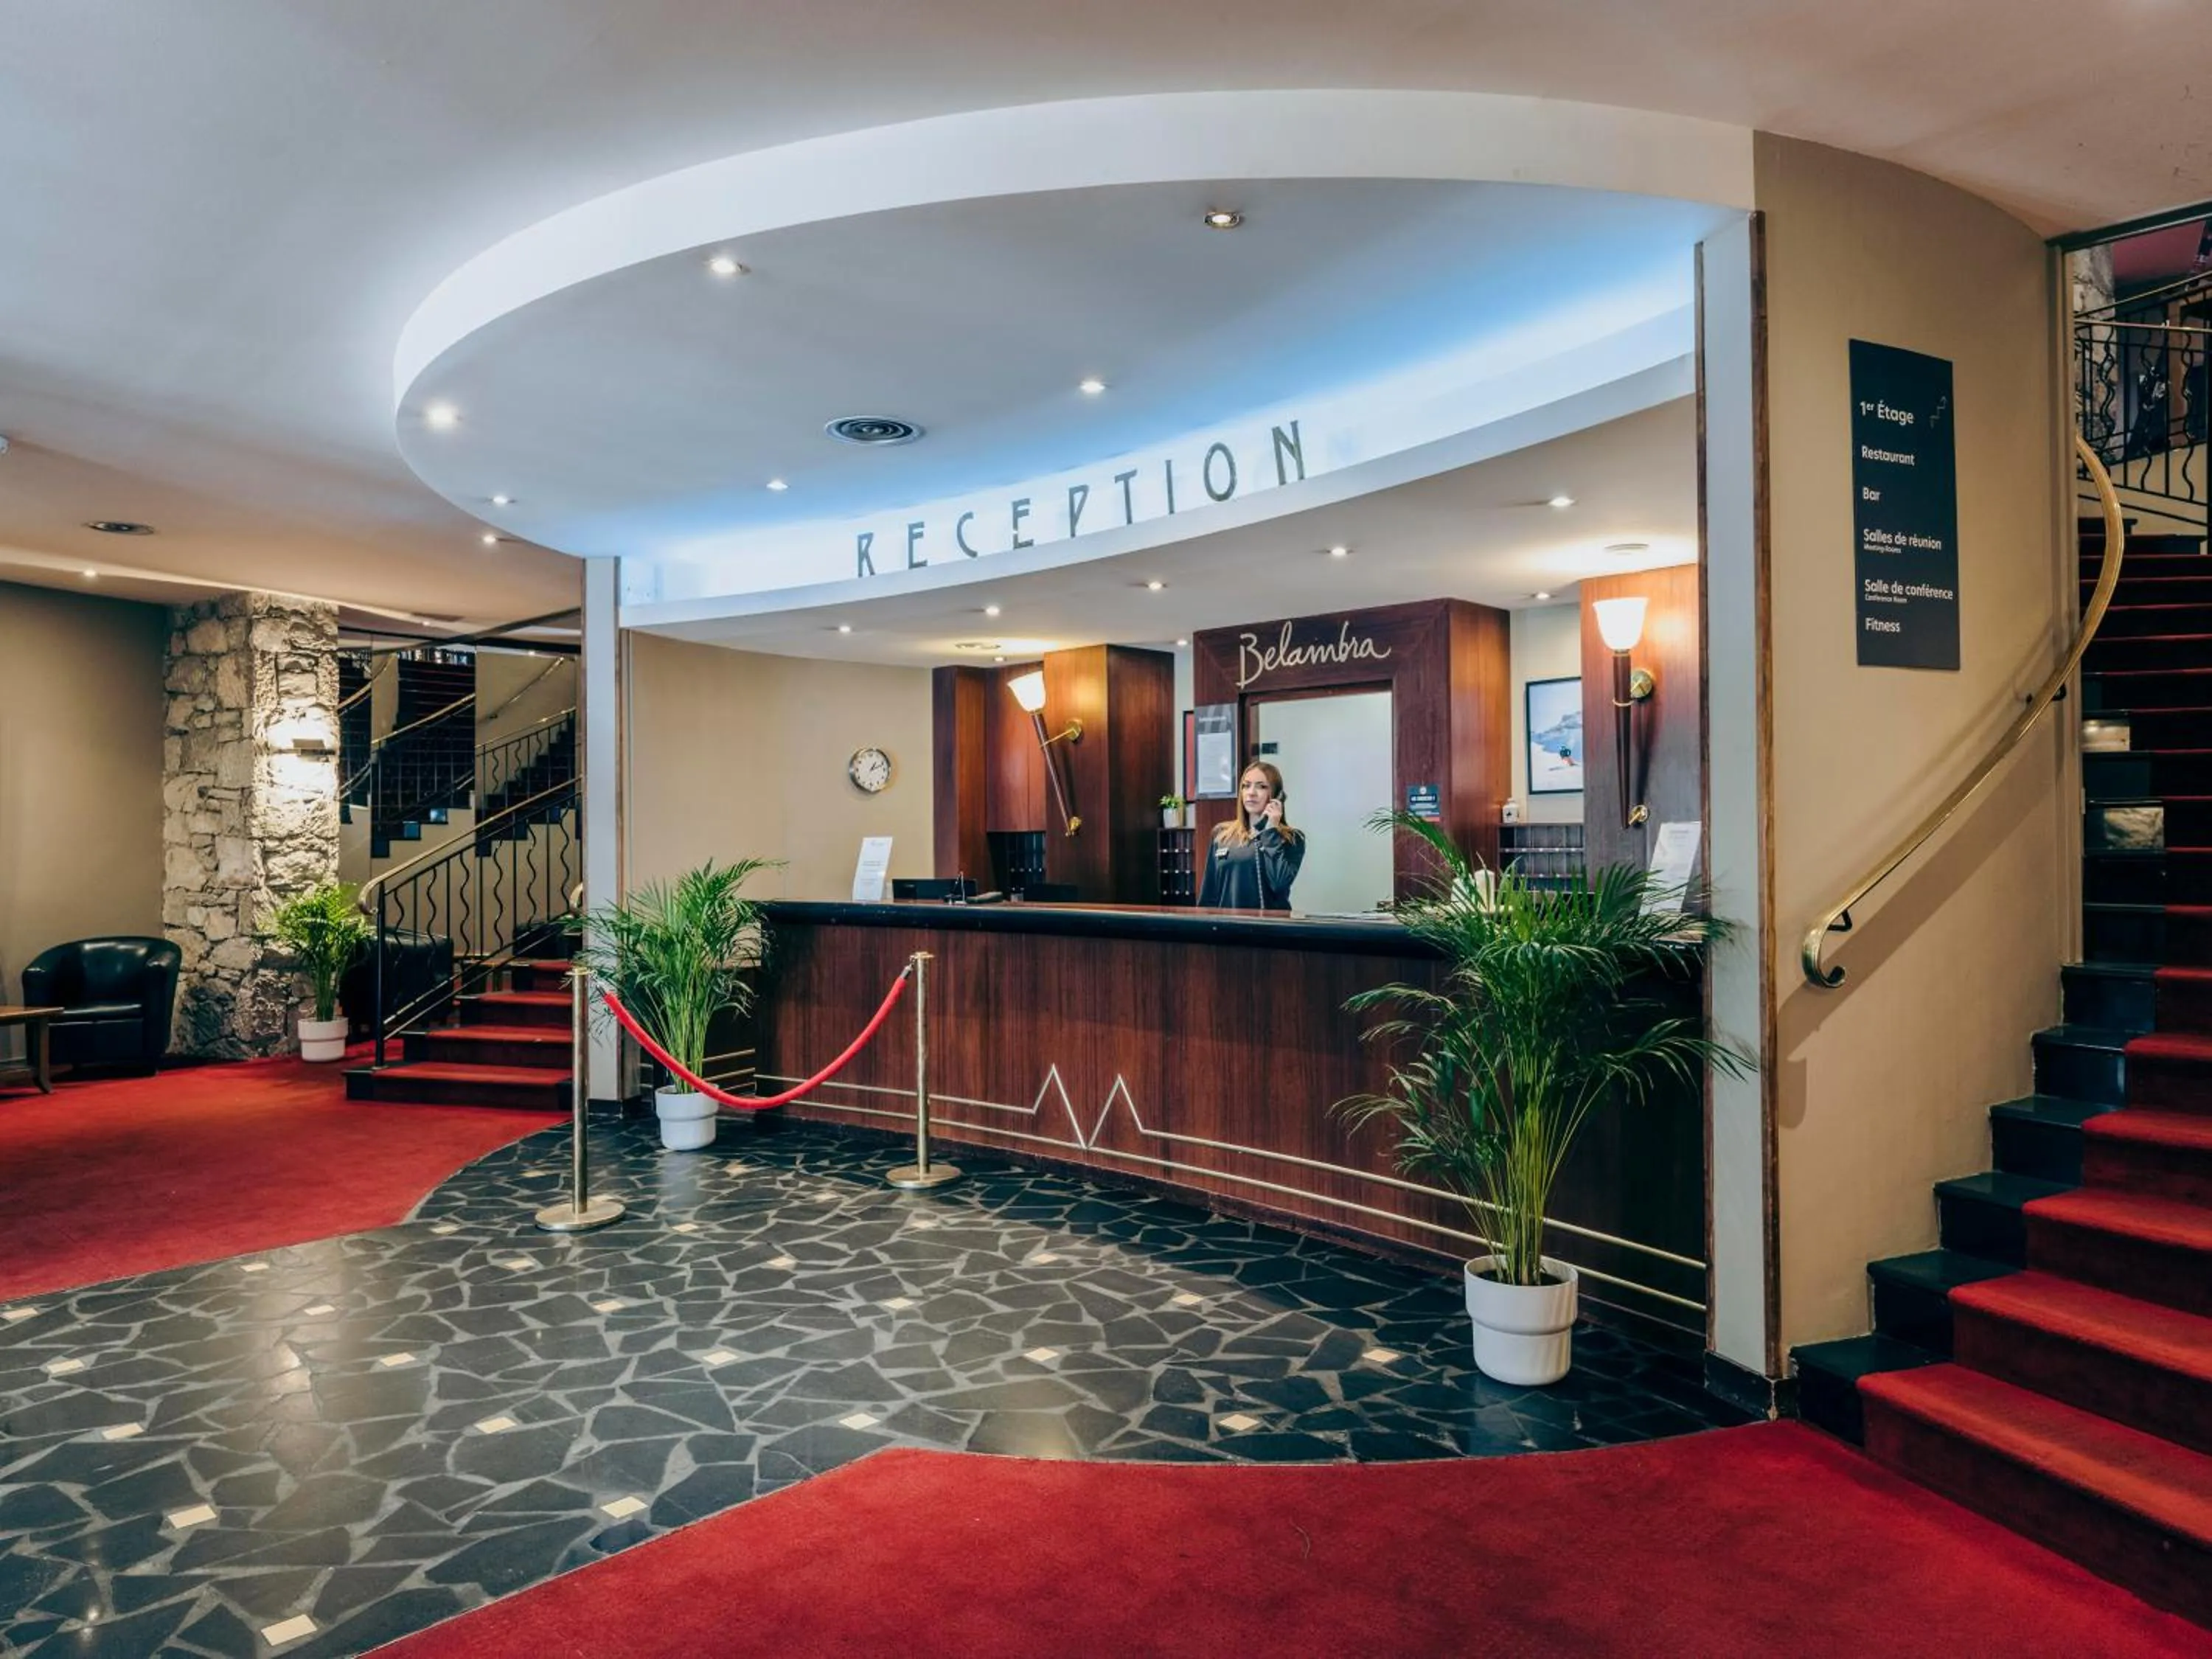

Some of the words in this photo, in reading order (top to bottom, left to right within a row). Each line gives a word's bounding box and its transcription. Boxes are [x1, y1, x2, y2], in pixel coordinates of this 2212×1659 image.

[1877, 400, 1914, 425] Étage
[1862, 445, 1915, 466] Restaurant
[856, 420, 1304, 578] RECEPTION
[1863, 487, 1880, 501] Bar
[1863, 529, 1893, 543] Salles
[1894, 532, 1907, 546] de
[1909, 535, 1941, 550] réunion
[1865, 580, 1889, 593] Salle
[1891, 580, 1904, 595] de
[1905, 584, 1953, 599] conférence
[1865, 618, 1901, 632] Fitness
[1236, 620, 1392, 689] Belambra
